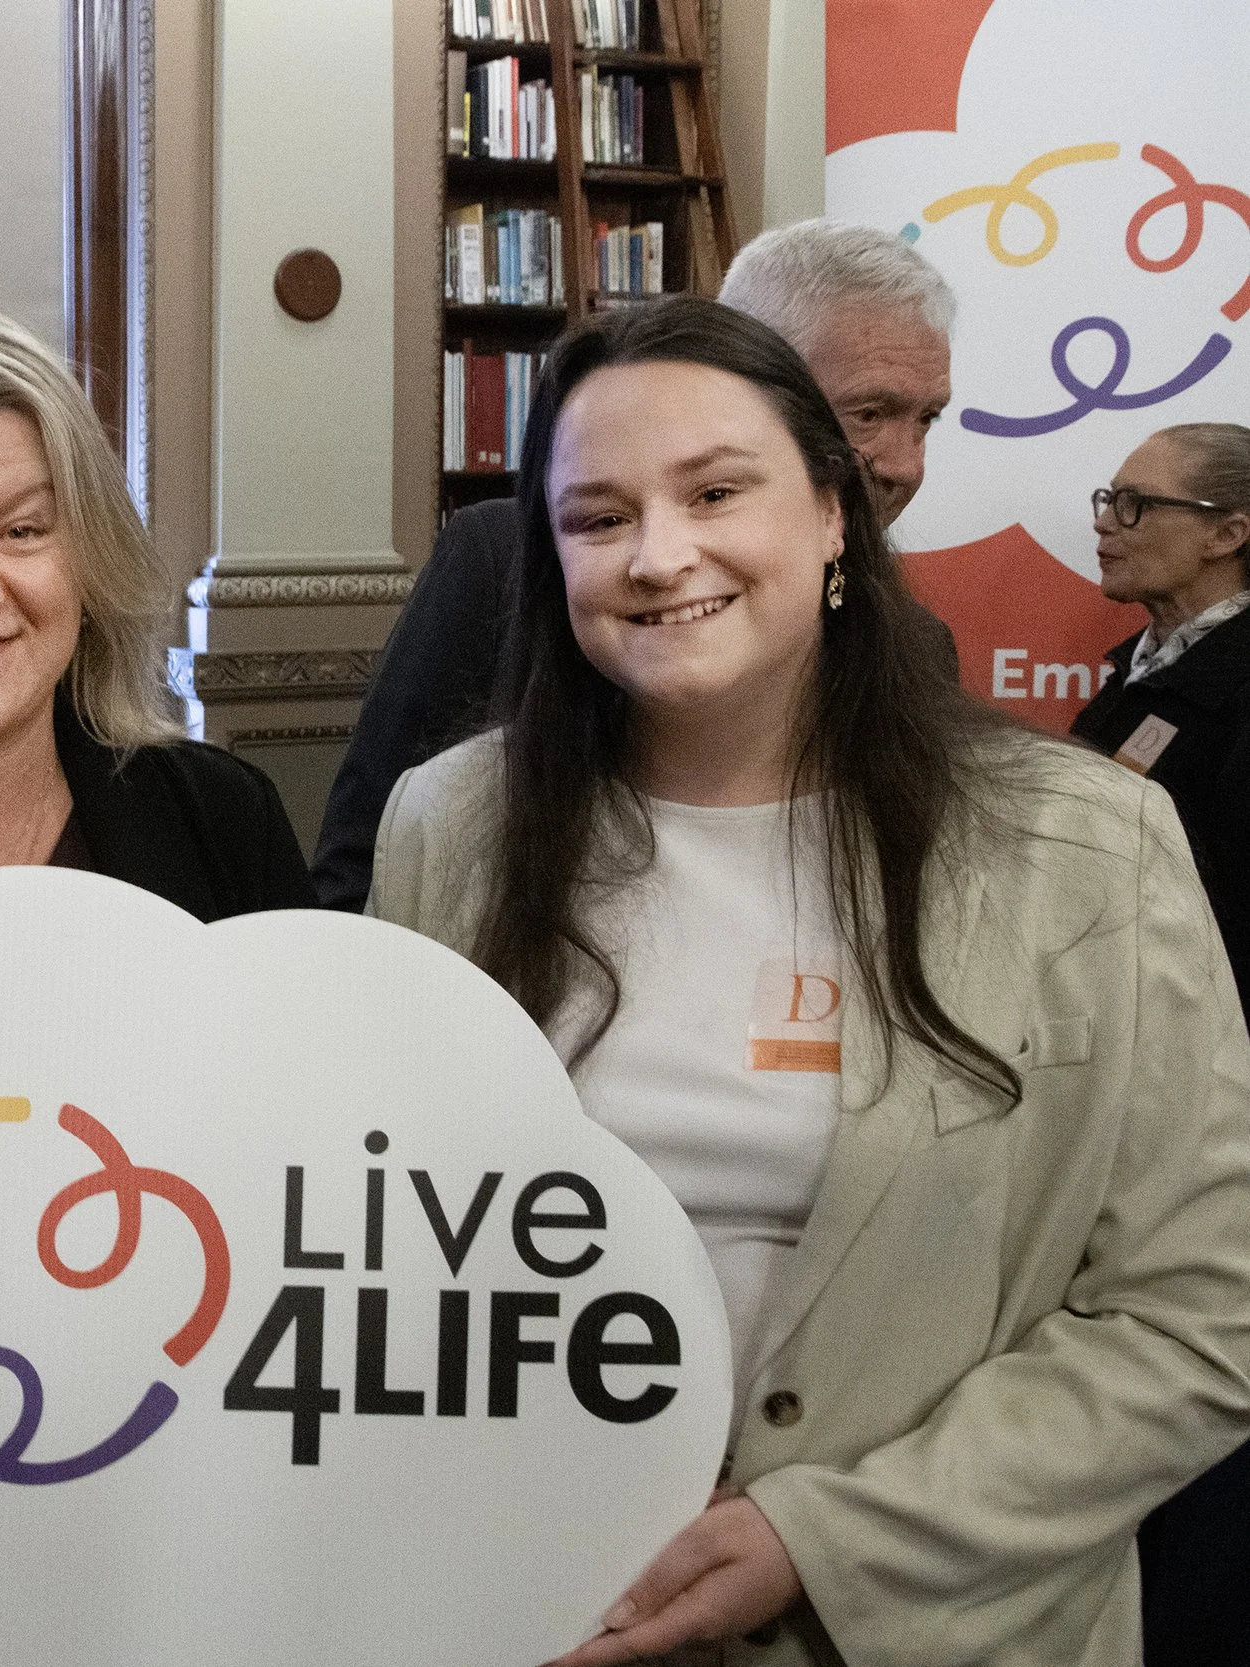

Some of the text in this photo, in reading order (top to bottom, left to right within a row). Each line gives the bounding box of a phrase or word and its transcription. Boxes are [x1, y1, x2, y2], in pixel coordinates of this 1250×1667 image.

[781, 973, 842, 1022] D
[283, 1129, 608, 1279] Live
[223, 1284, 682, 1466] 4LIFe
